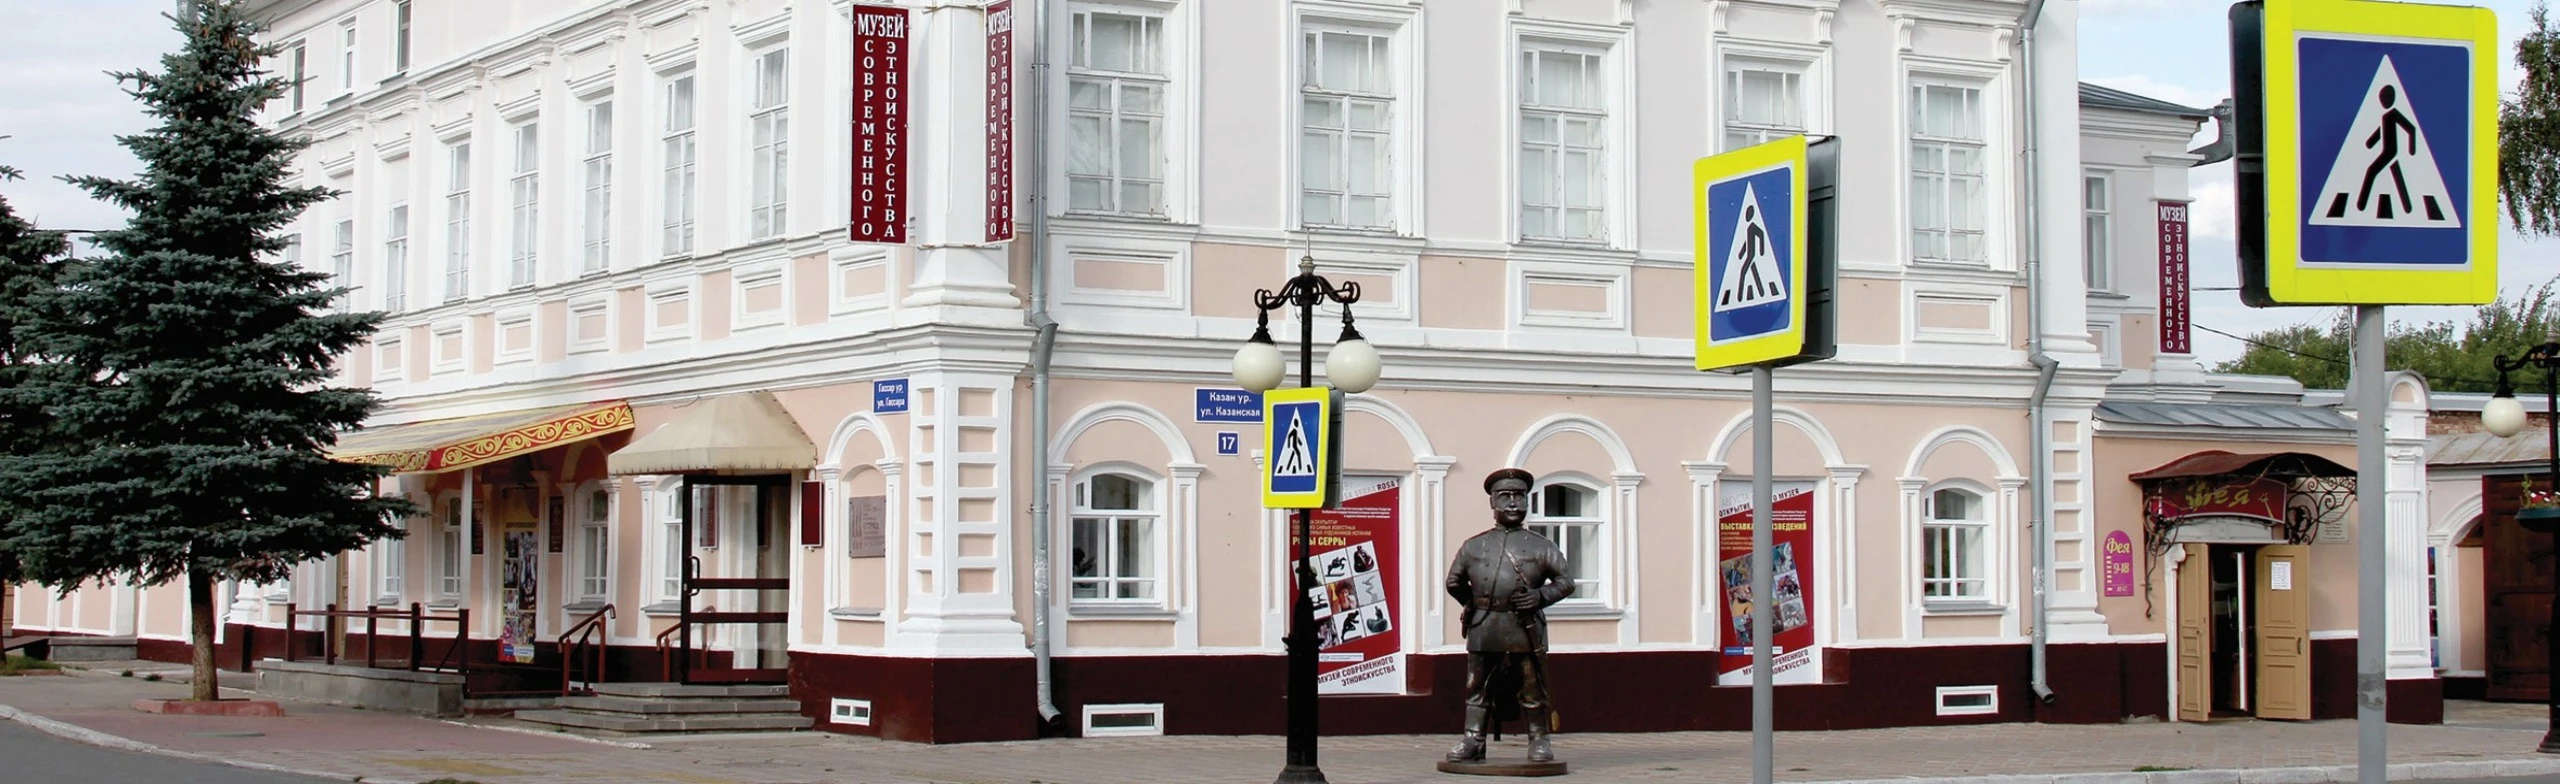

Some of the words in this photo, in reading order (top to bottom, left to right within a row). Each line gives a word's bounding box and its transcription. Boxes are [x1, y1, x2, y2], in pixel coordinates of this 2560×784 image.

[857, 13, 904, 38] МУЗЕЙ
[988, 7, 1010, 37] МУЗЕЙ
[861, 40, 875, 236] СОВРЕМЕННОГО
[884, 41, 897, 237] ЭТНОИСКУССТВА
[989, 38, 997, 236] СОВРЕМЕННОГО
[2160, 205, 2186, 222] МУЗЕЙ
[2164, 223, 2173, 349] СОВРЕМЕННОГО
[2176, 224, 2185, 350] ЭТНОИСКУССТВА
[1209, 392, 1236, 401] Казан
[1237, 395, 1252, 404] ур.
[1200, 408, 1213, 417] ул.
[1215, 406, 1260, 417] Казанская
[1221, 436, 1236, 450] 17
[1376, 480, 1395, 491] ROSA
[1779, 488, 1799, 500] МУЗЕЯ
[1719, 502, 1750, 517] ОТКРЫТИЕ
[1318, 536, 1346, 545] СЕРРЫ
[2106, 537, 2130, 554] Фея
[1772, 649, 1809, 666] РЕМЕННОГО
[1772, 657, 1810, 675] ОИСКУССТВА
[1317, 669, 1341, 684] МУЗЕЙ
[1341, 656, 1394, 677] СОВРЕМЕННОГО
[1341, 664, 1397, 686] ЭТНОИСКУССТВА
